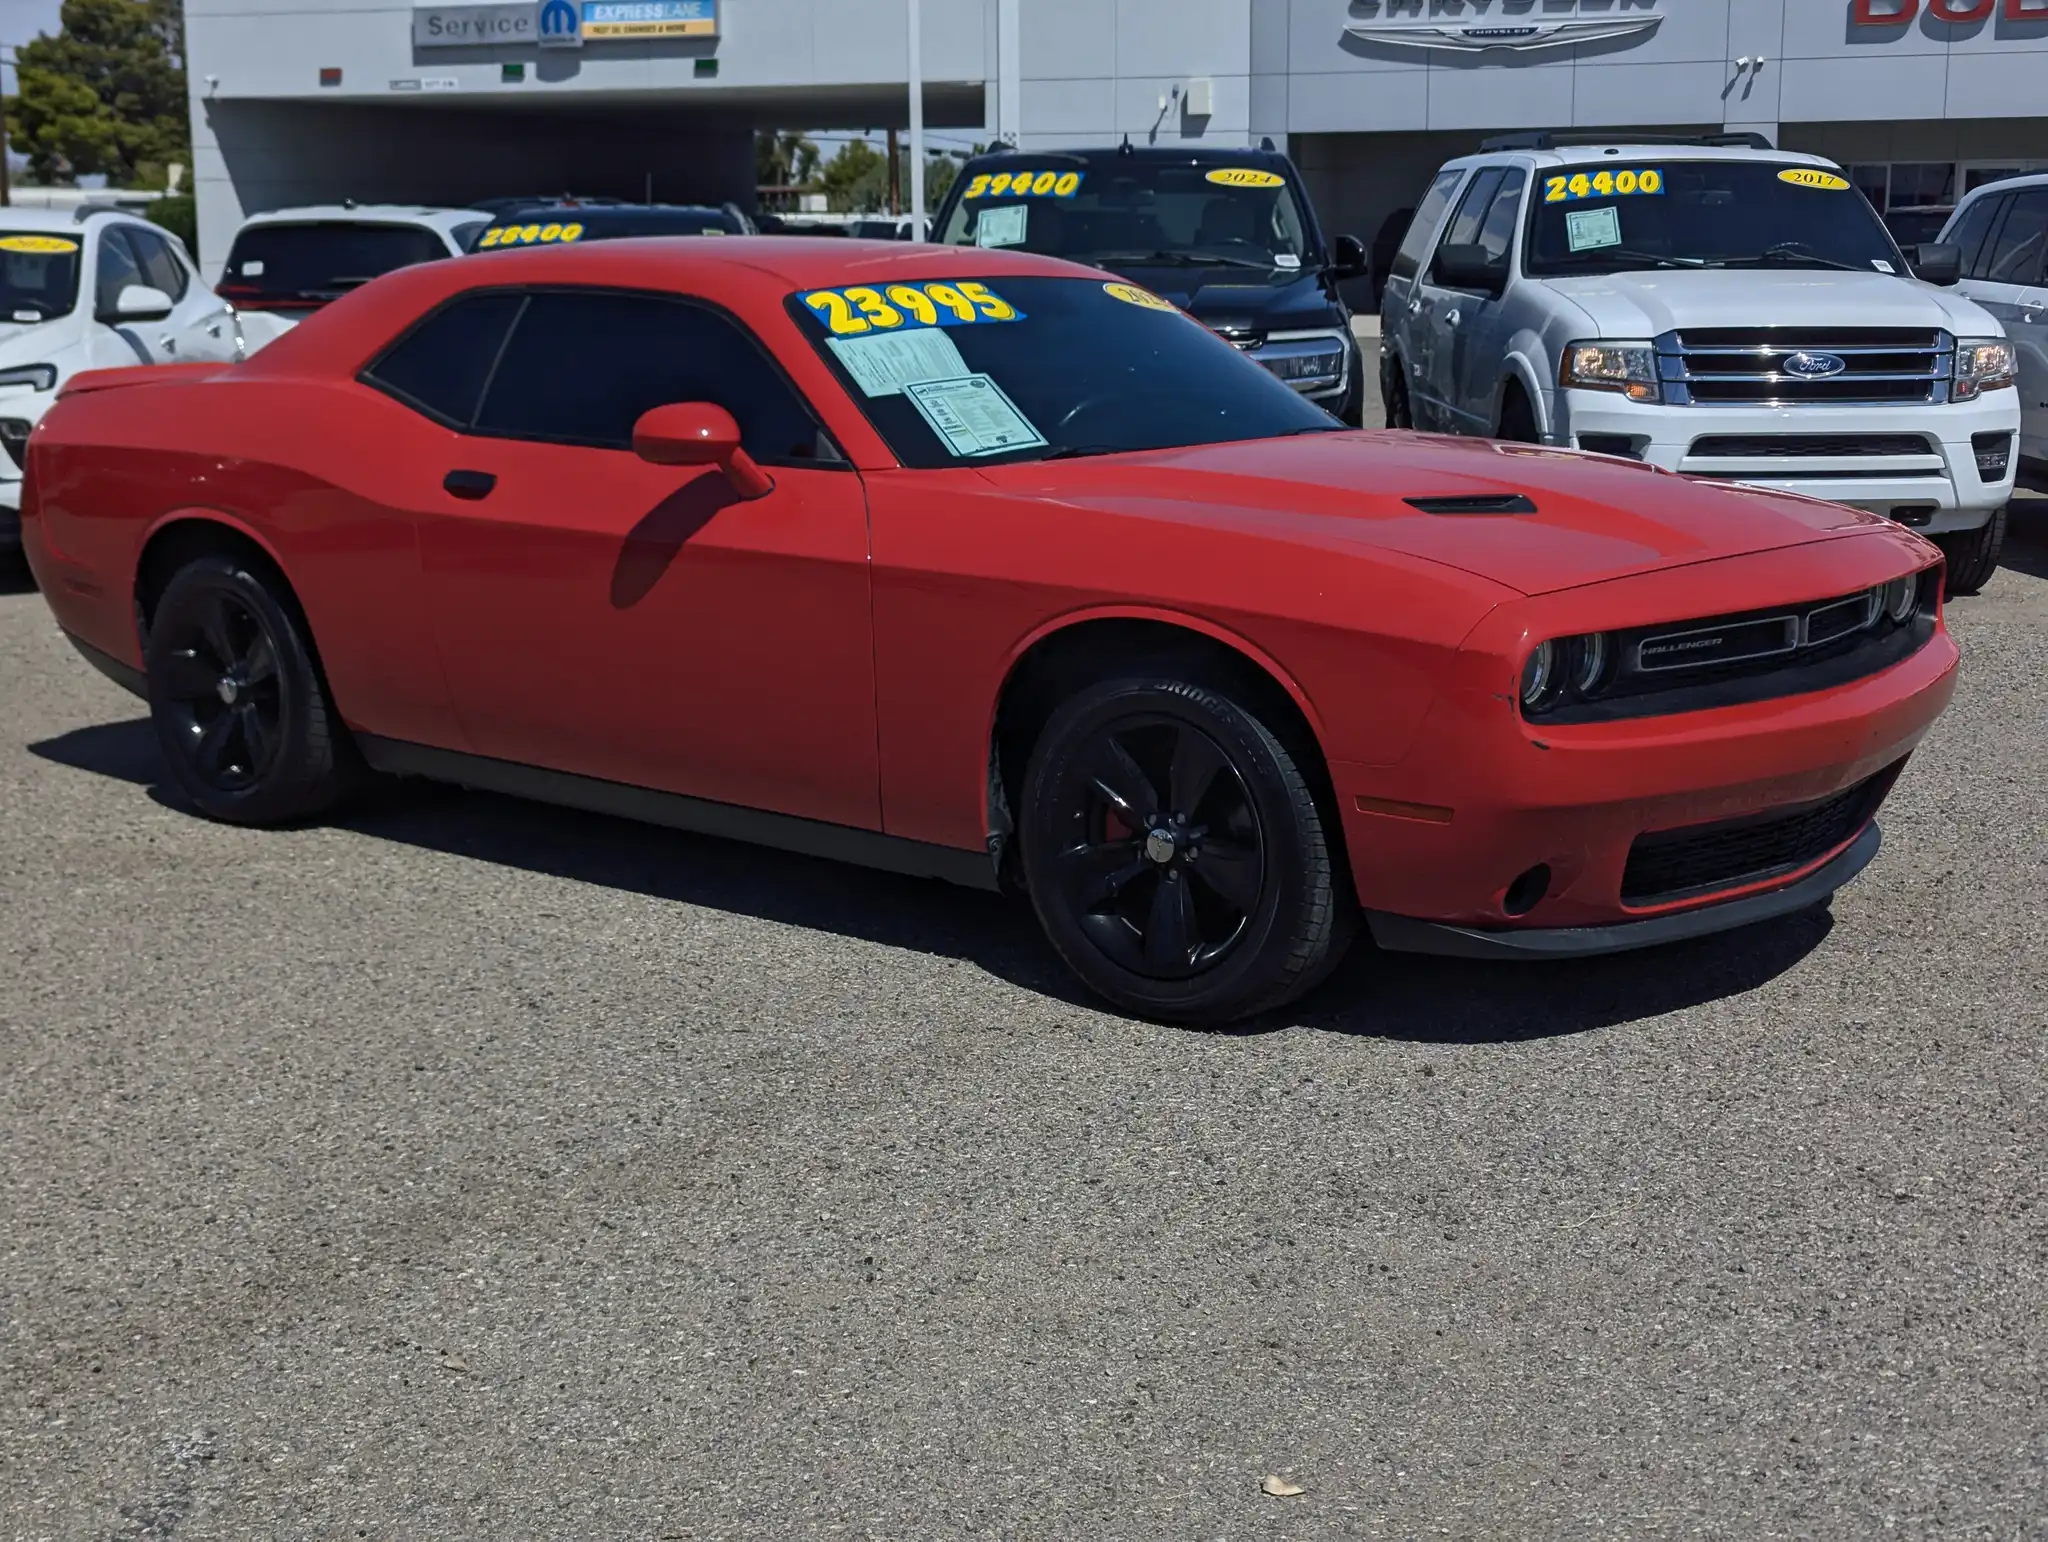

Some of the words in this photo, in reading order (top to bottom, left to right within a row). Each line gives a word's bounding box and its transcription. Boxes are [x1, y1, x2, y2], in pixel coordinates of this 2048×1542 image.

[428, 15, 529, 37] Service
[1468, 28, 1530, 36] CHRYSLER
[965, 171, 1079, 199] 39400
[1545, 169, 1661, 202] 24400
[1792, 172, 1837, 186] 2017
[805, 282, 1016, 334] 23995
[1800, 357, 1832, 371] Ford
[1642, 637, 1723, 655] HALLENGER
